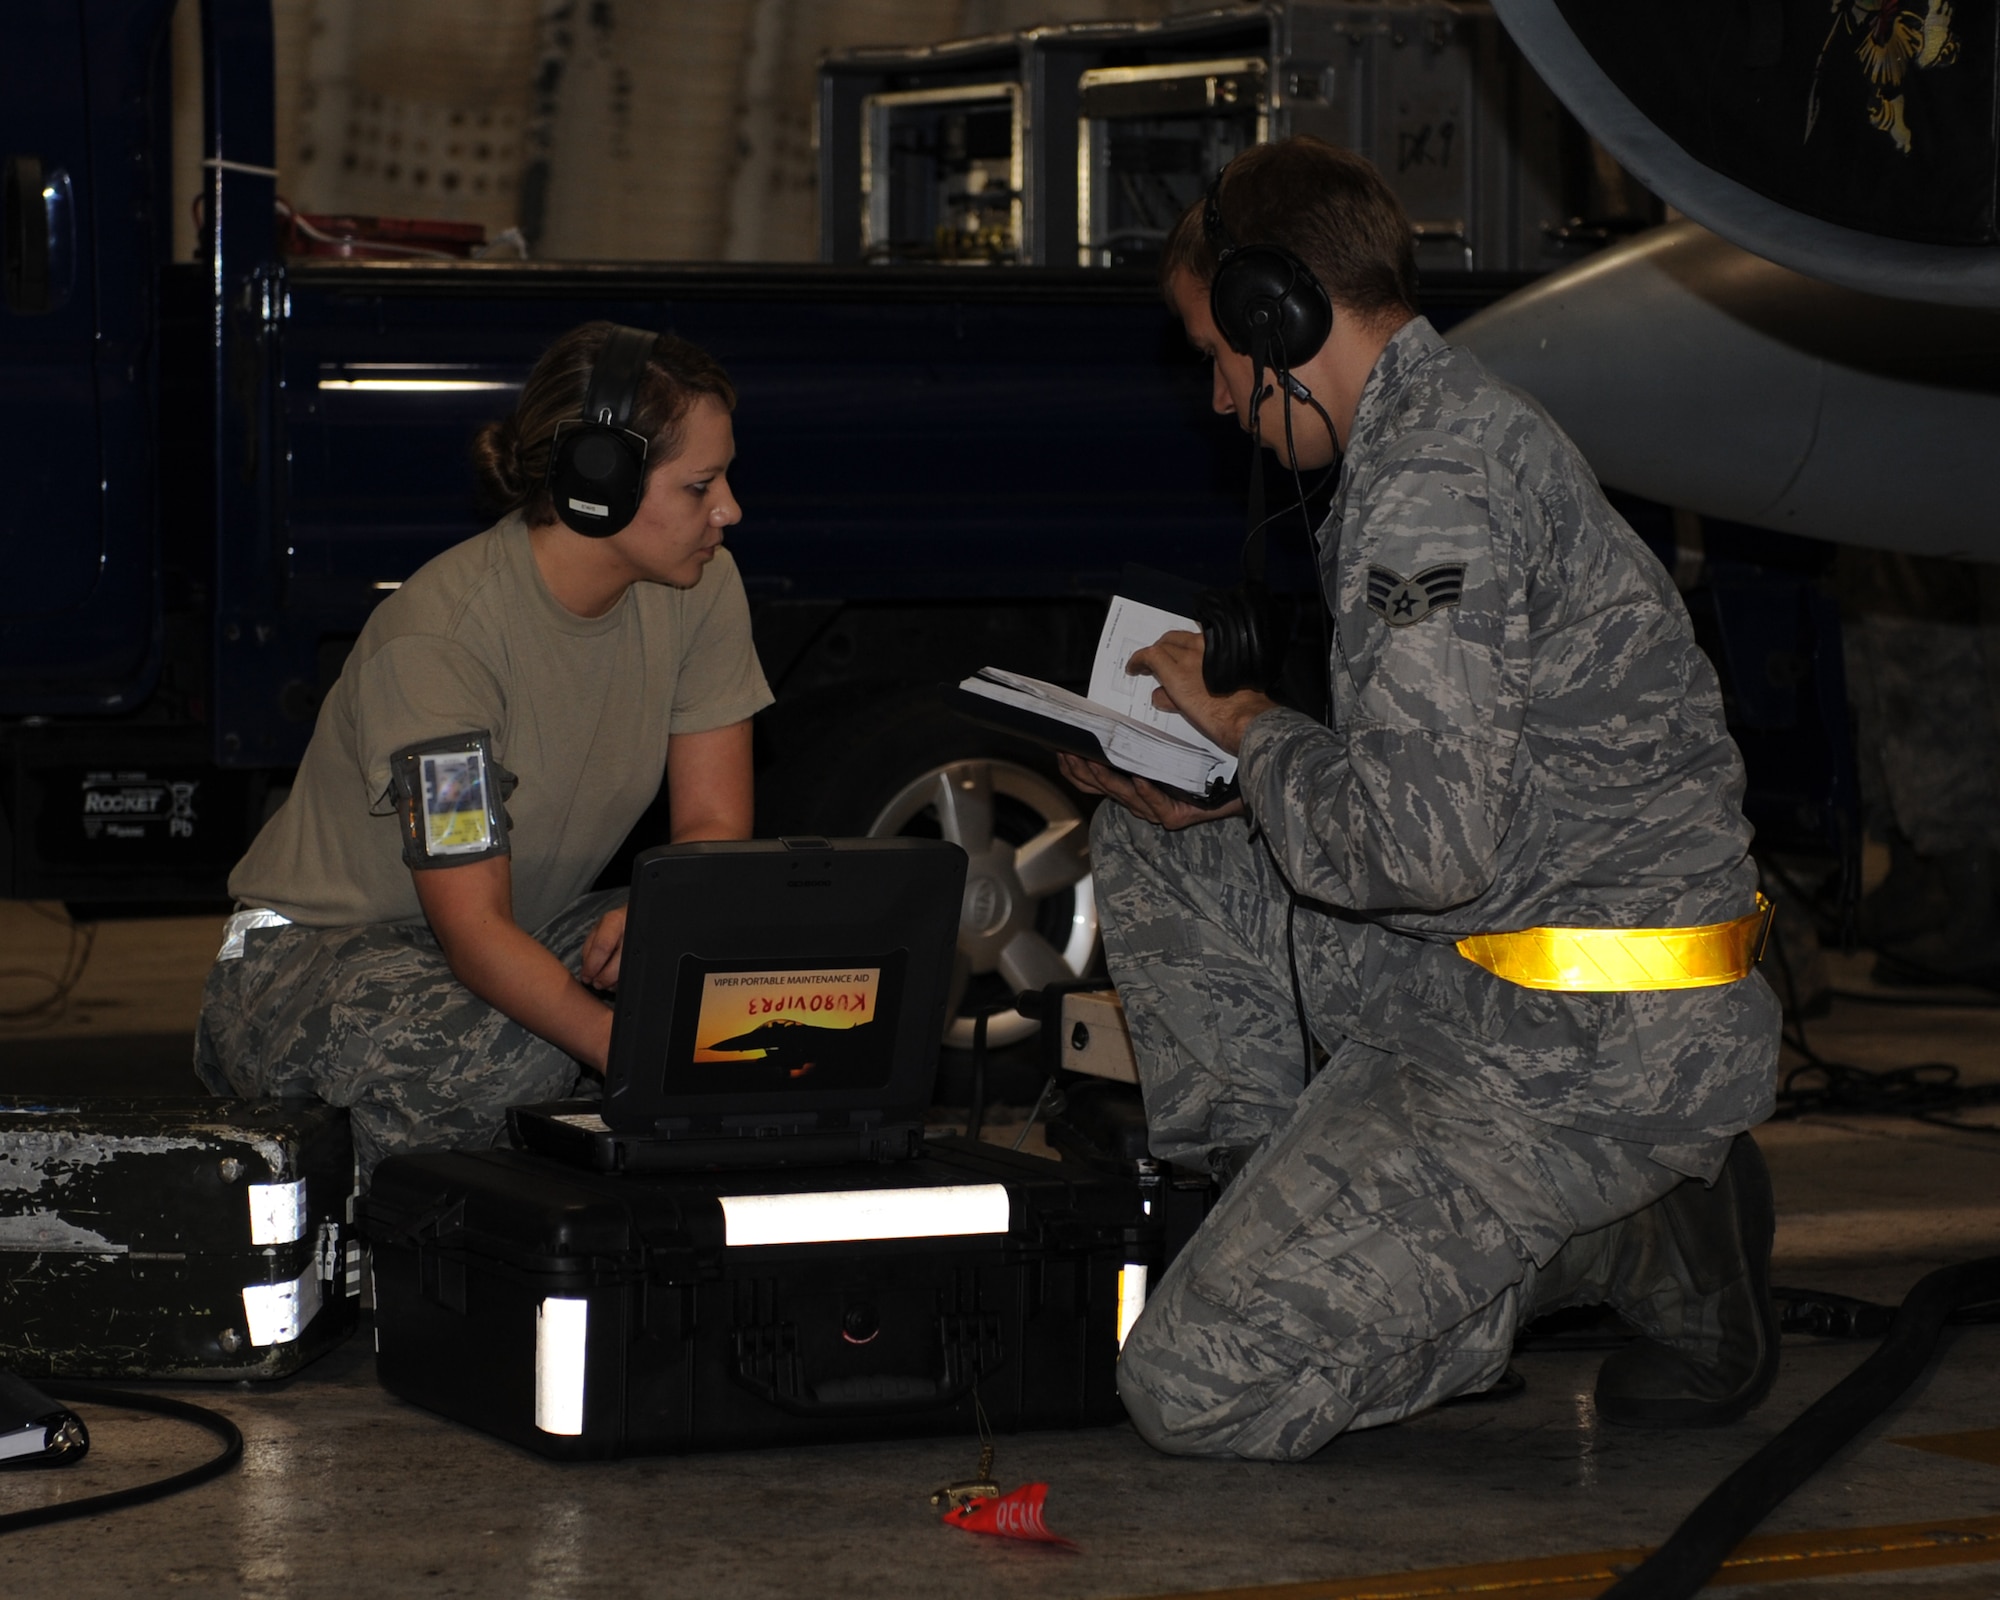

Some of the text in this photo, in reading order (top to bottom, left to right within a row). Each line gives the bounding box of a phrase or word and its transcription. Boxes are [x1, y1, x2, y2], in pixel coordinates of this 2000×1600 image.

[714, 974, 870, 987] VIPER PORTABLE MAINTENANCE AID
